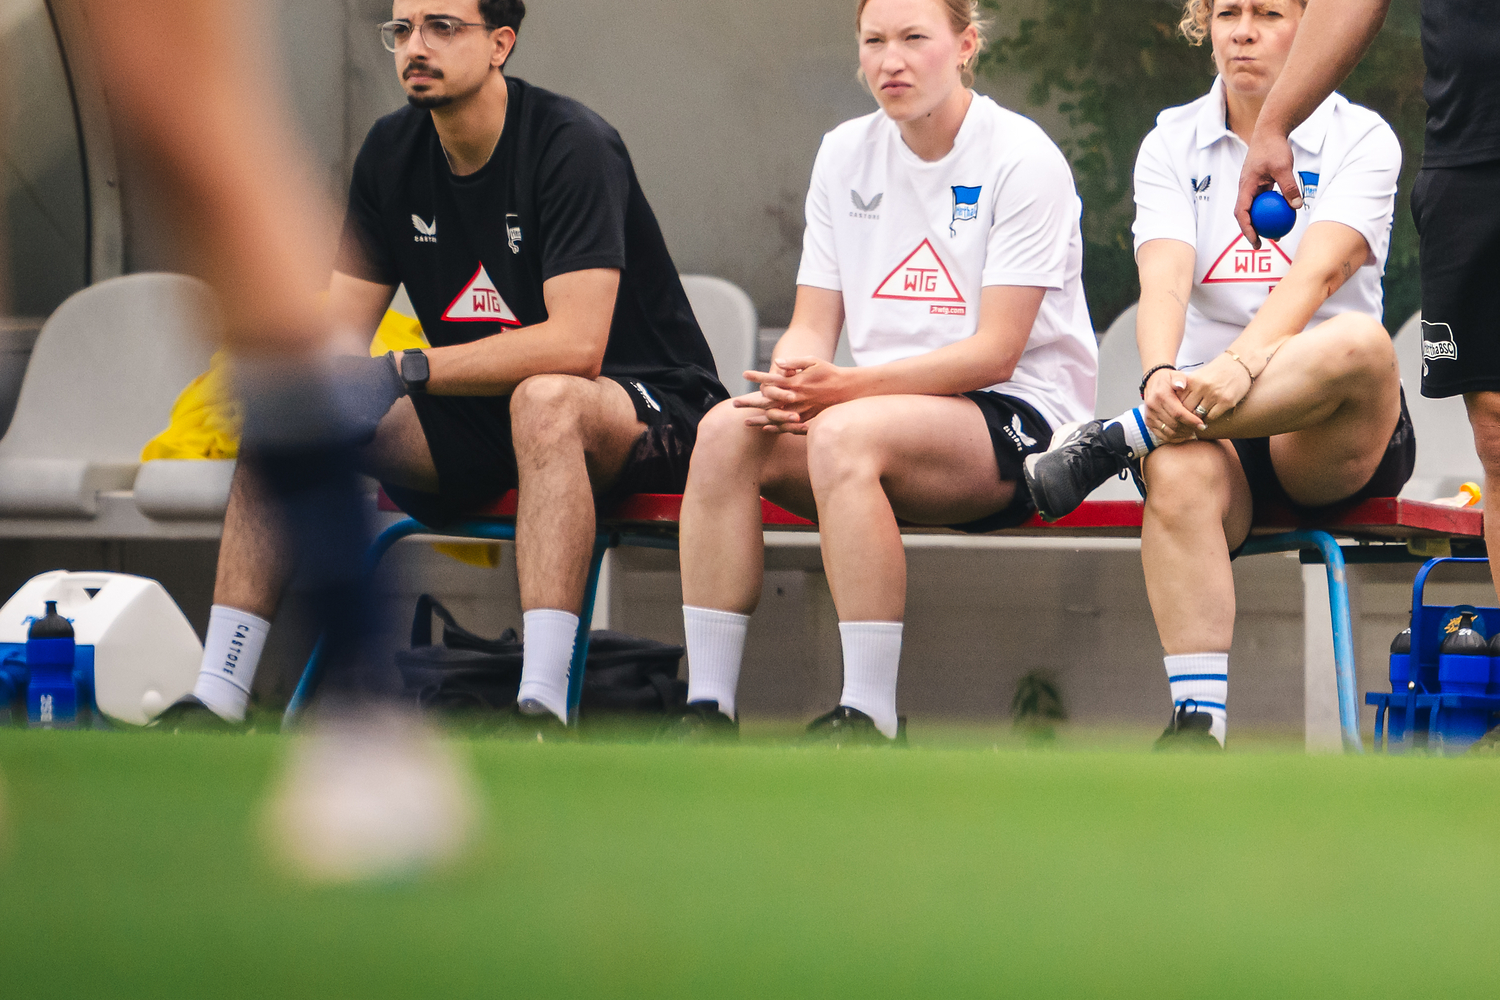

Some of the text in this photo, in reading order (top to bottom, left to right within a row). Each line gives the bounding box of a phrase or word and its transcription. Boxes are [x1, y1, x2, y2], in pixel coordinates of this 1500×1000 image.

[1234, 248, 1272, 274] WTG
[904, 267, 939, 292] WTG
[472, 287, 502, 313] WTG
[223, 624, 250, 676] CASTORE
